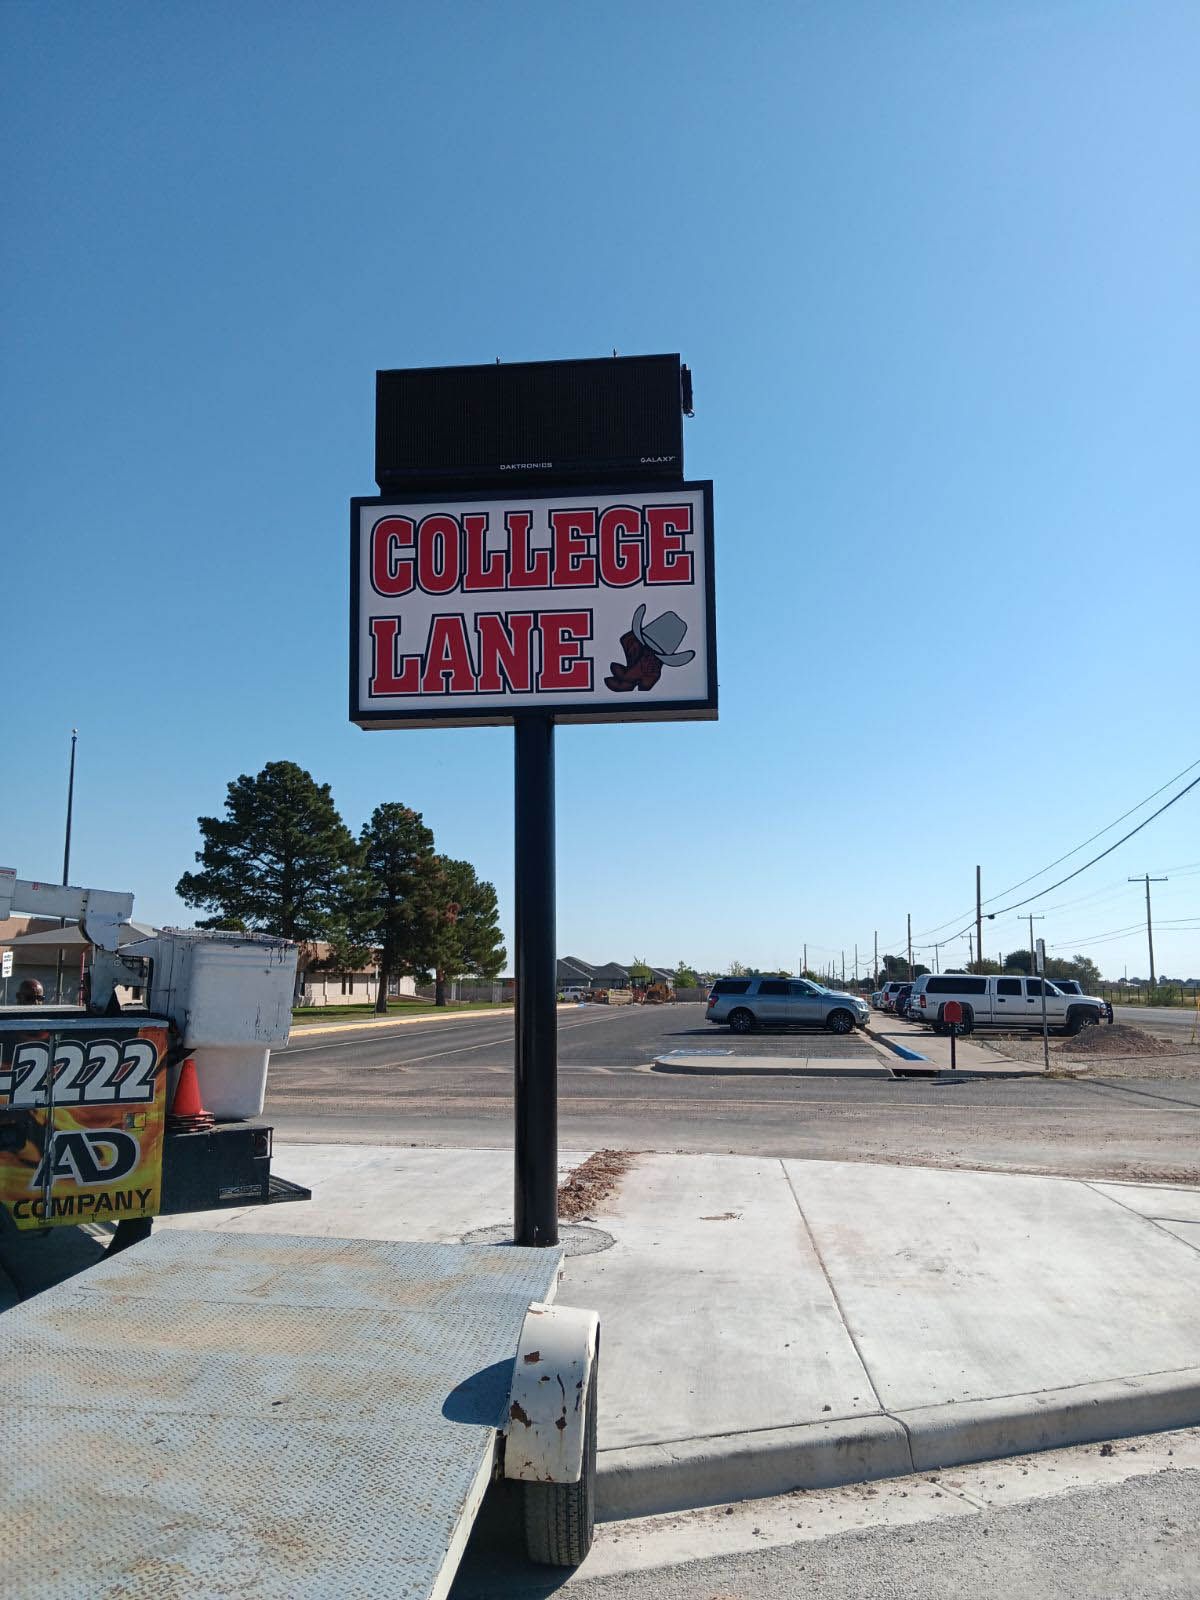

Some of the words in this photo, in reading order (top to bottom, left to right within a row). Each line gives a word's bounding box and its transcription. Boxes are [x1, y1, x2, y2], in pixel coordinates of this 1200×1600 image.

[499, 462, 553, 471] DAKTRONICS
[640, 455, 674, 464] GALAXY
[370, 503, 694, 598] COLLEGE
[368, 608, 593, 698] LANE
[13, 1188, 152, 1219] COMPANY
